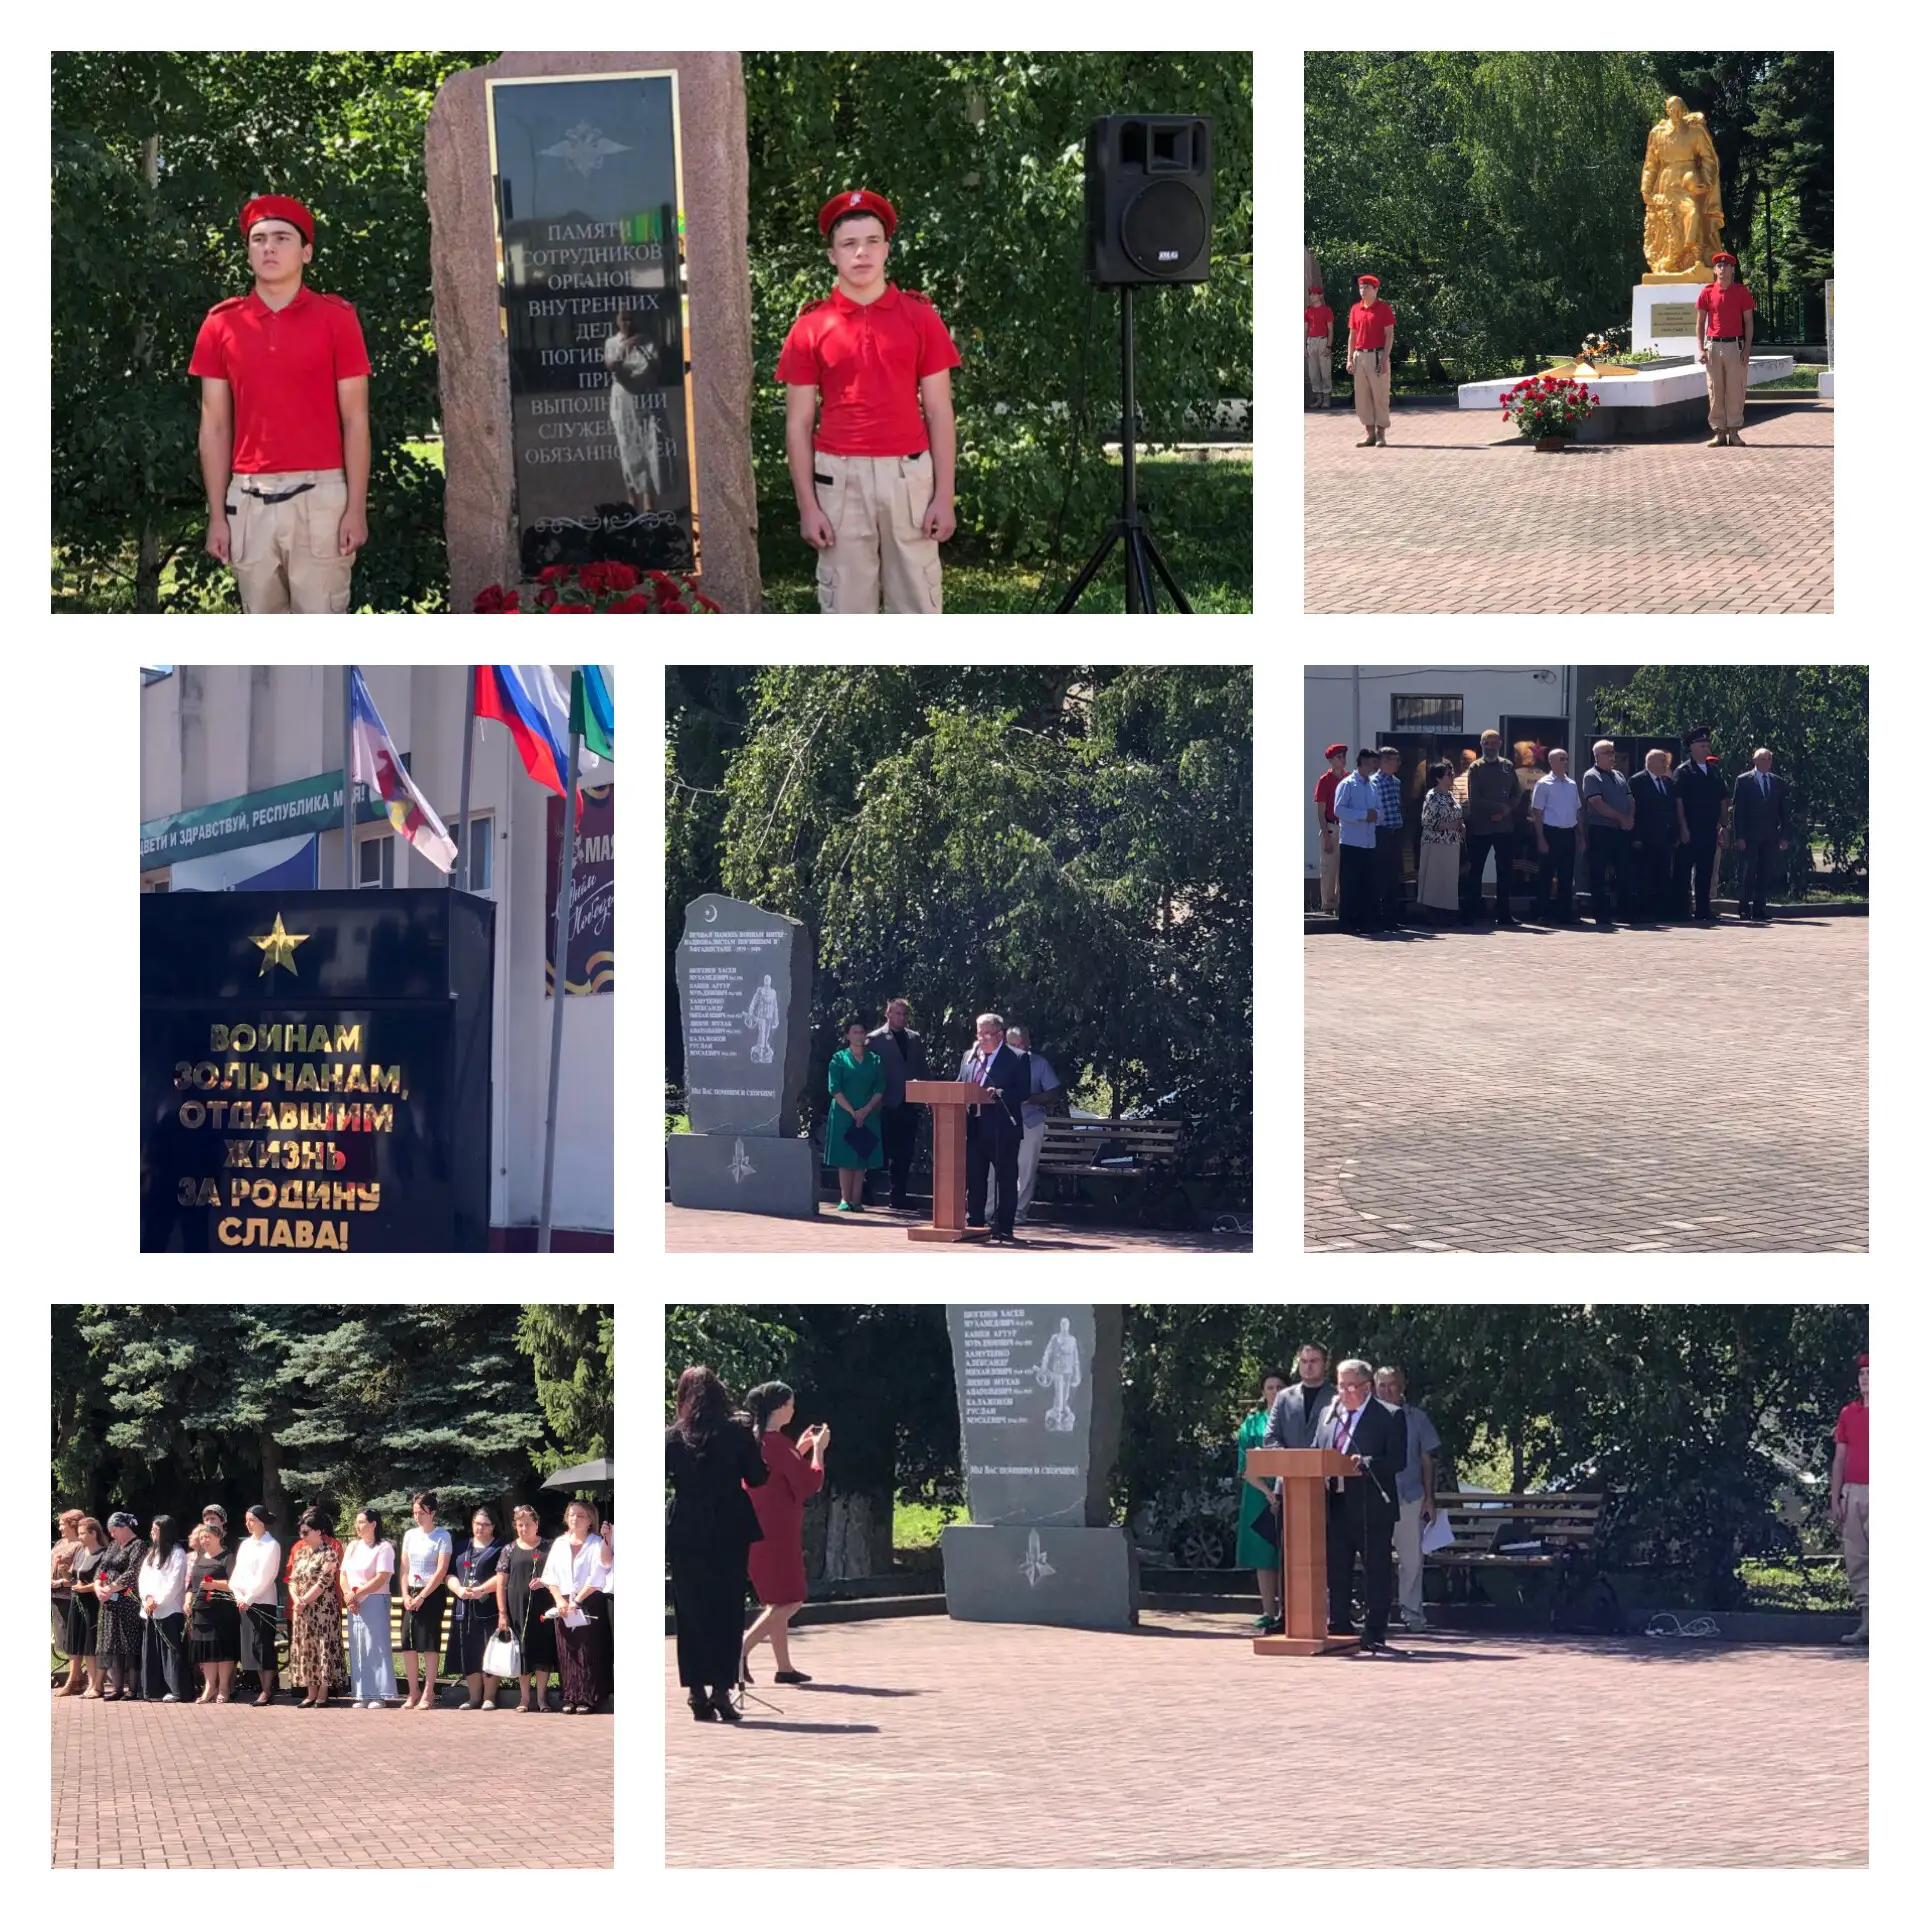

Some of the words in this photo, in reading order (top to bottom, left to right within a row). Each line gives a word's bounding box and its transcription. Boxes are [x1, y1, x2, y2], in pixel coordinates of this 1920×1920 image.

[548, 221, 632, 241] ПАМЯТИ
[522, 244, 663, 267] СОТРУДНИКОВ
[528, 294, 660, 317] ВНУТРЕННИХ
[576, 322, 614, 342] ДЕЛ
[541, 344, 658, 366] ПОГИБИХ
[579, 372, 616, 388] ПРИ
[531, 393, 667, 416] ВЫПОЛНИИ
[538, 417, 662, 440] СЛУЖЕБХ
[525, 438, 677, 464] ОБЯЗАННОЕЙ
[170, 834, 177, 847] И
[179, 811, 249, 847] ЗДРАВСТВУЙ,
[252, 796, 329, 827] РЕСПУБЛИКА
[333, 785, 365, 809] МЯ!
[585, 834, 614, 863] МА
[210, 1023, 362, 1053] ВОИНАМ
[173, 1061, 409, 1100] ЗОЛЬЧАНАМ,
[178, 1100, 393, 1133] ОТДАВШИМ
[223, 1139, 346, 1171] ЖИЗНЬ
[177, 1177, 221, 1207] ЗА
[231, 1178, 381, 1212] РОДИНУ
[217, 1216, 348, 1252] СЛАВА!
